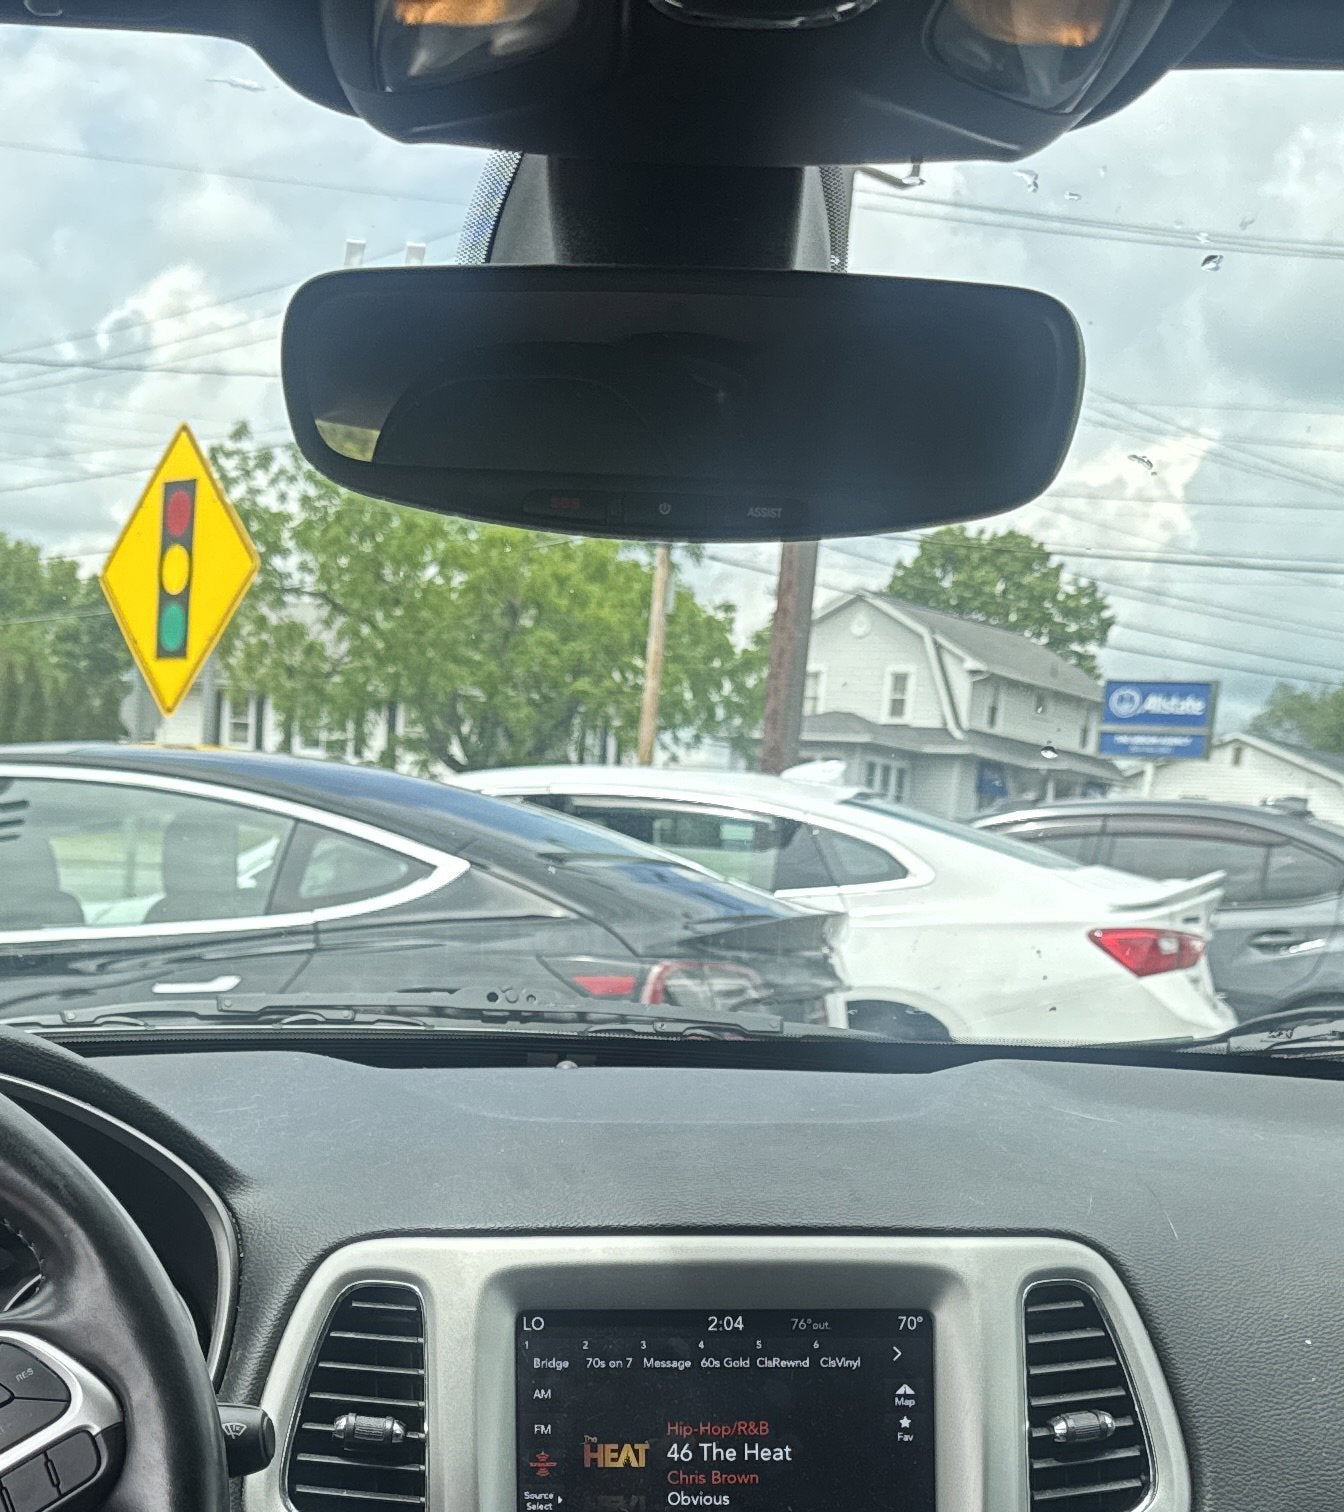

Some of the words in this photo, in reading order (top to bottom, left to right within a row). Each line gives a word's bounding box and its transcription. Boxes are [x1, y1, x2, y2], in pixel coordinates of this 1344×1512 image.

[746, 507, 783, 519] ASSIST
[522, 1316, 545, 1331] LO
[707, 1316, 745, 1331] 2:04
[524, 1340, 529, 1350] 1
[582, 1340, 589, 1350] 2
[640, 1340, 647, 1350] 3
[698, 1340, 705, 1350] 4
[756, 1340, 762, 1350] 5
[813, 1340, 820, 1350] 6
[533, 1357, 569, 1371] Bridge
[585, 1357, 606, 1369] 70s
[608, 1360, 623, 1369] on
[625, 1357, 633, 1369] 7
[643, 1357, 692, 1371] Message
[700, 1357, 721, 1369] 60s
[723, 1356, 751, 1369] Gold
[819, 1356, 862, 1371] ClsVinyl
[532, 1388, 552, 1400] AM
[894, 1397, 916, 1409] Map
[533, 1424, 552, 1435] FM
[666, 1420, 770, 1438] Hip-Hop/R&B
[897, 1432, 914, 1442] Fav
[583, 1443, 650, 1468] HEAT
[666, 1443, 693, 1462] 46
[699, 1442, 737, 1462] The
[744, 1442, 792, 1462] Heat
[667, 1470, 706, 1486] Chris
[711, 1470, 759, 1486] Brown
[523, 1491, 554, 1501] Source
[667, 1490, 730, 1506] Obvious
[526, 1502, 553, 1511] Select
